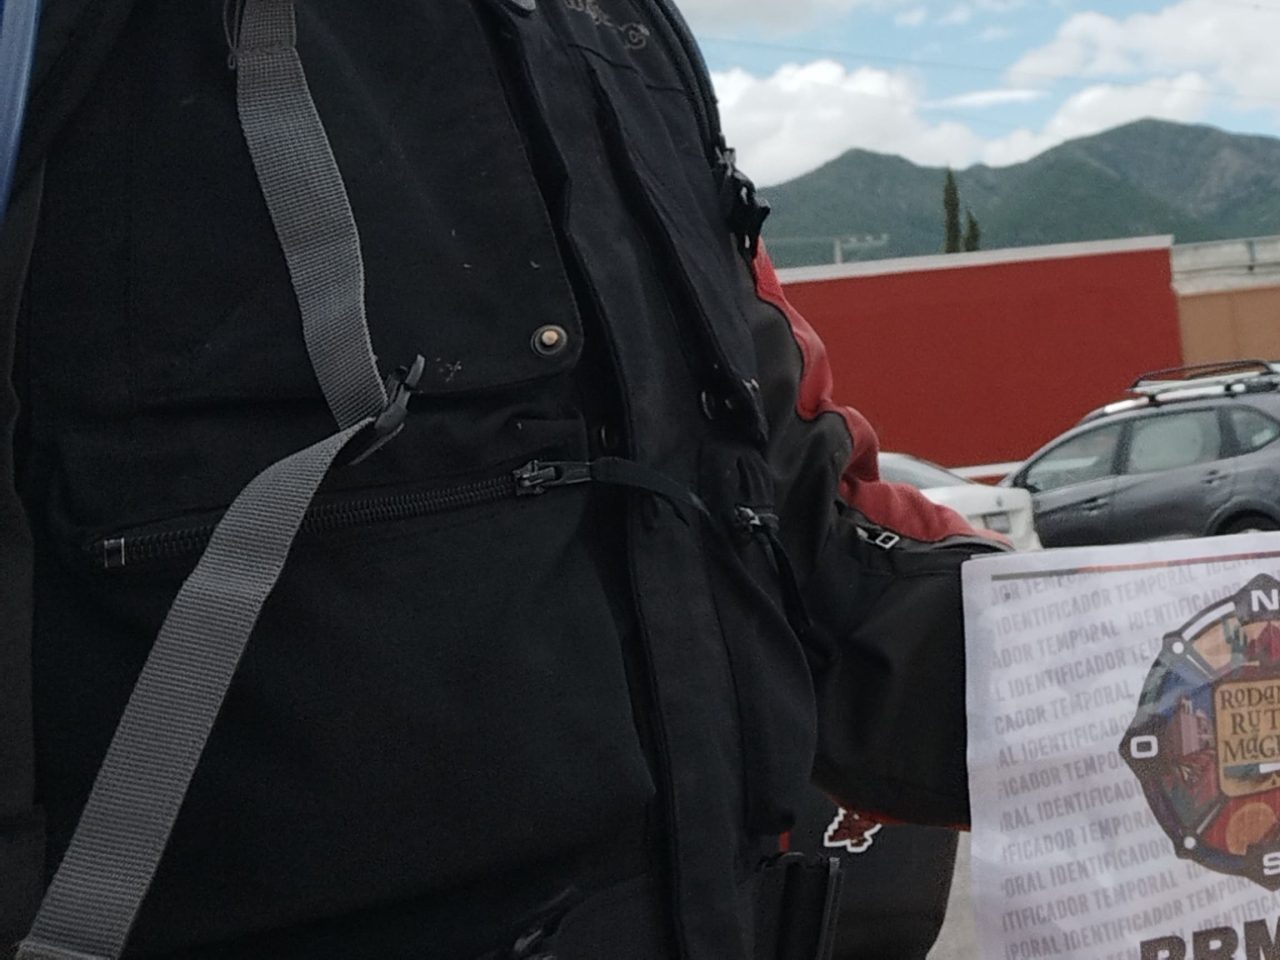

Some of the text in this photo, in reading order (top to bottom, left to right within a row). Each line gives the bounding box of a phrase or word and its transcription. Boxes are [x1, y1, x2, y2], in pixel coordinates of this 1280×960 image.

[994, 588, 1113, 637] IDENTIFICADOR
[1112, 565, 1199, 605] TEMPORAL
[1251, 588, 1280, 613] N
[1036, 618, 1120, 659] TEMPORAL
[1007, 647, 1126, 699] IDENTIFICADOR
[1048, 680, 1134, 720] TEMPORAL
[1130, 734, 1159, 759] O
[1049, 837, 1172, 887] IDENTIFICADOR
[1094, 869, 1179, 910] TEMPORAL
[1062, 898, 1185, 952] IDENTIFICADOR
